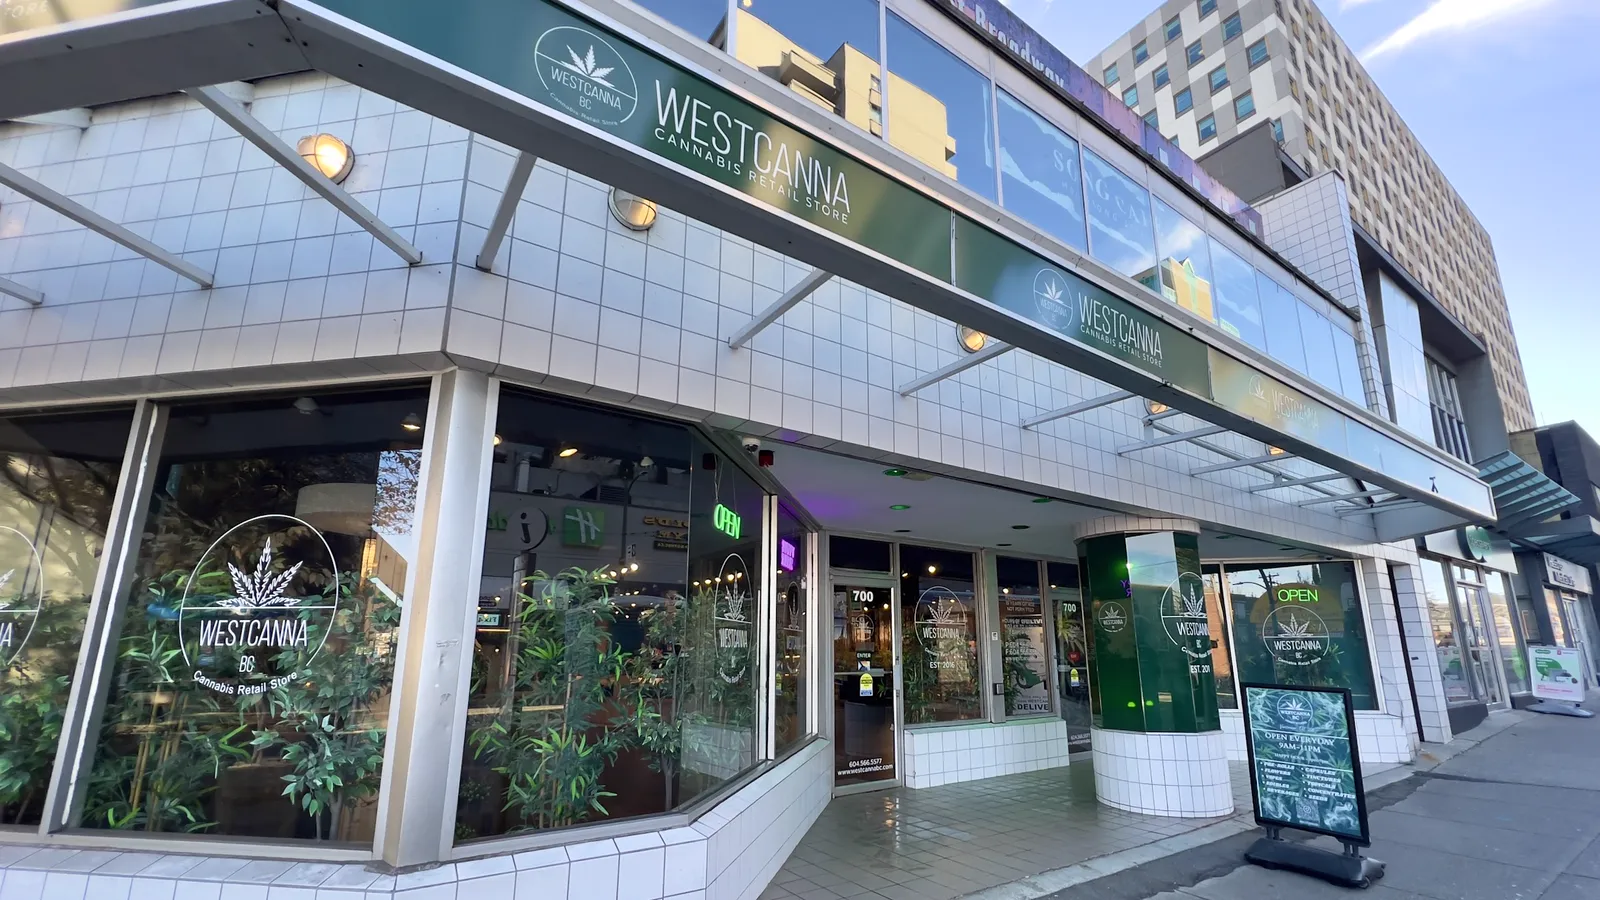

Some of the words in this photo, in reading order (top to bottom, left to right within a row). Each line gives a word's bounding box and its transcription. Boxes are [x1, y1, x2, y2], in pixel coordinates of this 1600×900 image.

[551, 66, 621, 110] WESTCANNA
[579, 95, 592, 110] BC
[655, 79, 850, 213] WESTCANNA
[654, 127, 742, 175] CANNABIS
[749, 170, 799, 203] RETAIL
[805, 197, 848, 225] STORE
[1078, 292, 1163, 359] WESTCANNA
[1080, 324, 1117, 347] CANNABIS
[1118, 343, 1141, 359] RETAIL
[1142, 354, 1163, 368] STORE
[714, 504, 741, 540] OPEN
[853, 590, 874, 602] 700
[1278, 589, 1319, 602] OPEN
[1063, 603, 1077, 612] 700
[199, 619, 308, 647] WESTCANNA
[923, 627, 960, 639] WESTCANNA
[1273, 640, 1322, 650] WESTCANNA
[239, 655, 255, 673] BC
[194, 670, 234, 694] Cannabis
[237, 682, 266, 695] Retail
[270, 671, 297, 689] Store
[1265, 732, 1288, 741] OPEN
[1289, 734, 1335, 746] EVERYDAY
[1279, 742, 1321, 753] 9AM-11PM
[849, 758, 883, 768] 604.566.5577
[838, 764, 894, 776] www.westcannabc.com
[1265, 768, 1291, 776] FLOWERS
[1305, 767, 1336, 776] CAPSULES
[1307, 774, 1341, 783] TINCTURES
[1267, 788, 1300, 796] BEVERAGES
[1308, 788, 1356, 799] CONCENTRATES
